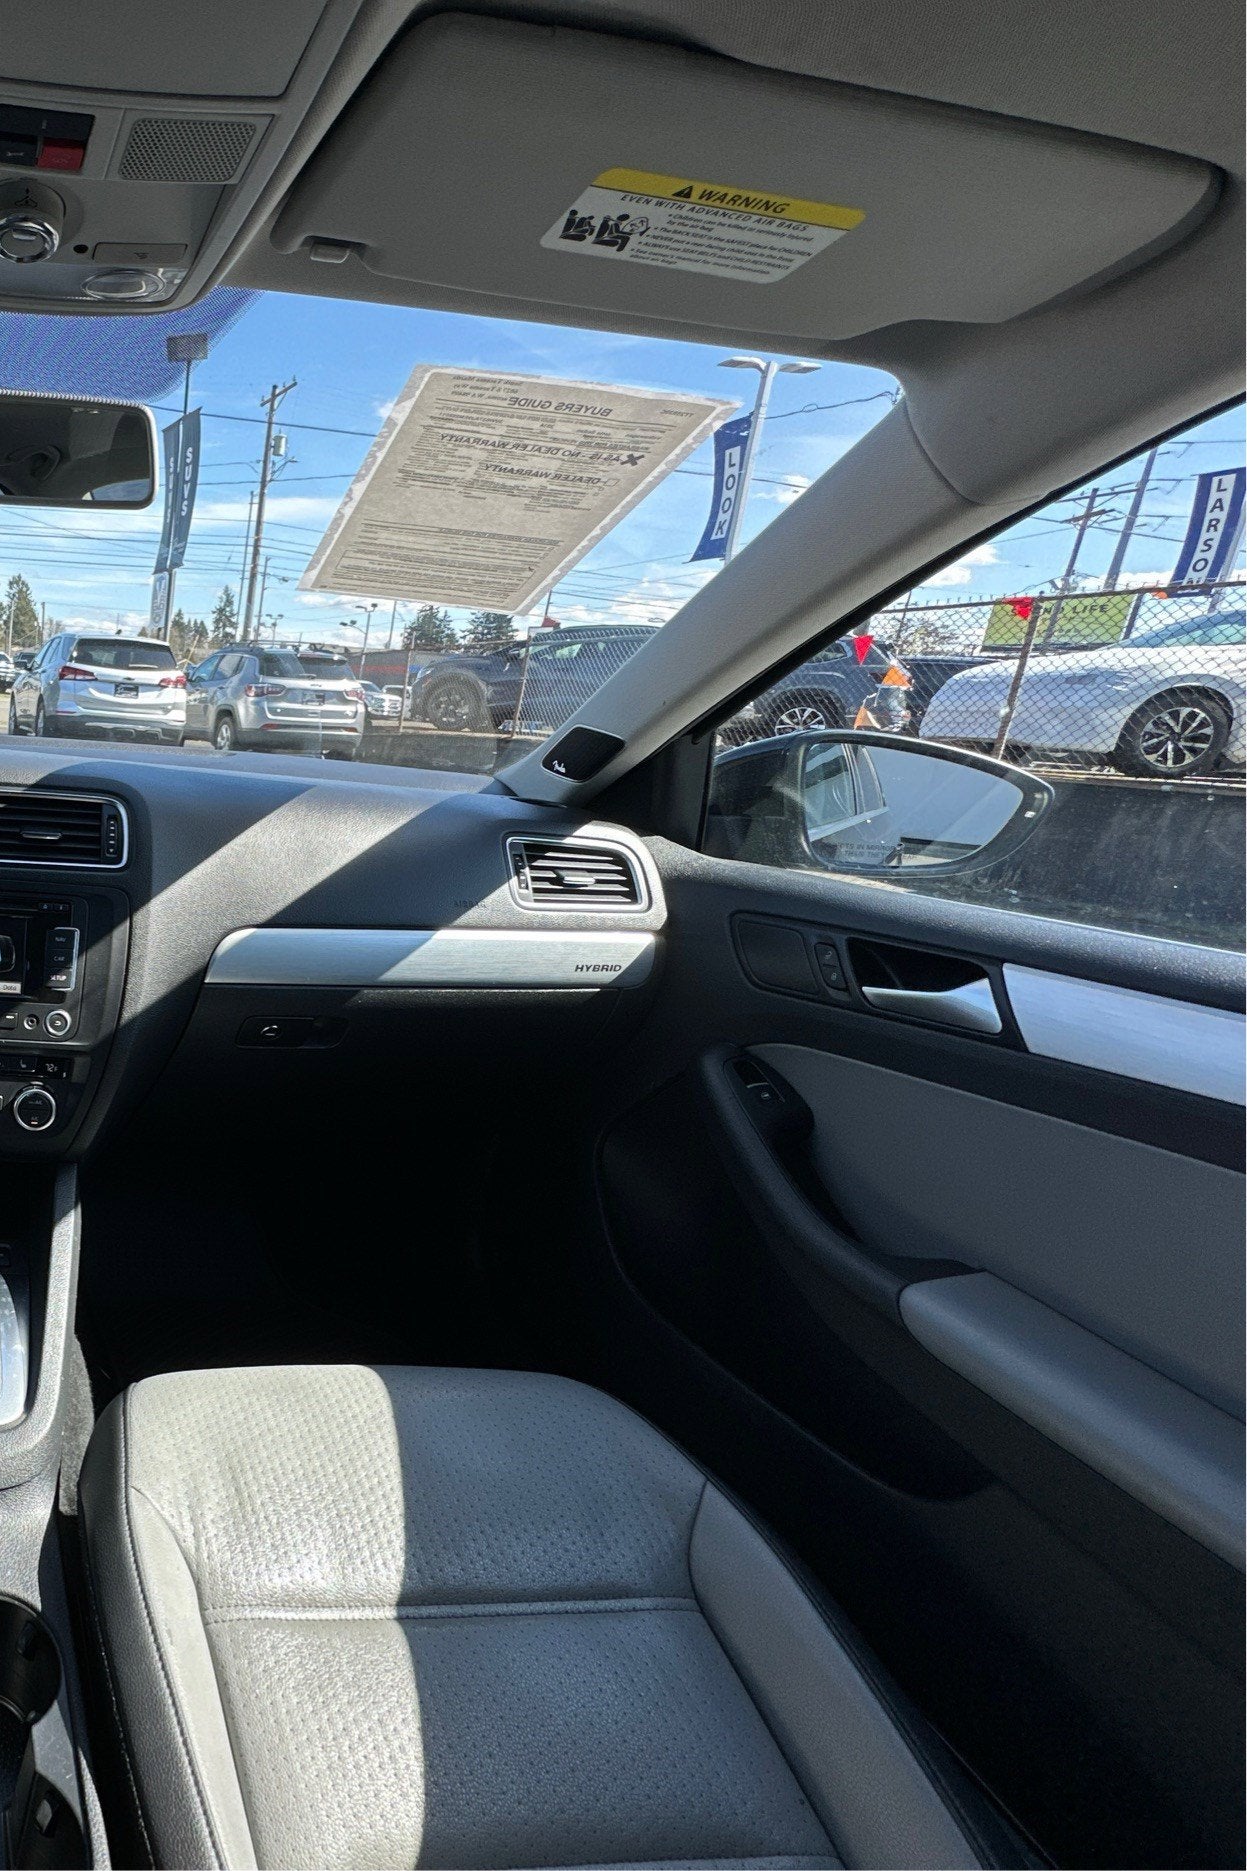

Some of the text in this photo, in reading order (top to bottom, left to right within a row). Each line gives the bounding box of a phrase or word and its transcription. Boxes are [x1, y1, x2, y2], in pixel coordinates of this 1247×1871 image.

[621, 194, 808, 233] EVEN WITH ADVANCED AIR BAGS
[698, 188, 790, 214] WARNING
[181, 446, 193, 516] SUVS
[715, 452, 736, 536] LOOK
[1072, 604, 1109, 614] LIFE
[574, 963, 622, 973] HYBRID
